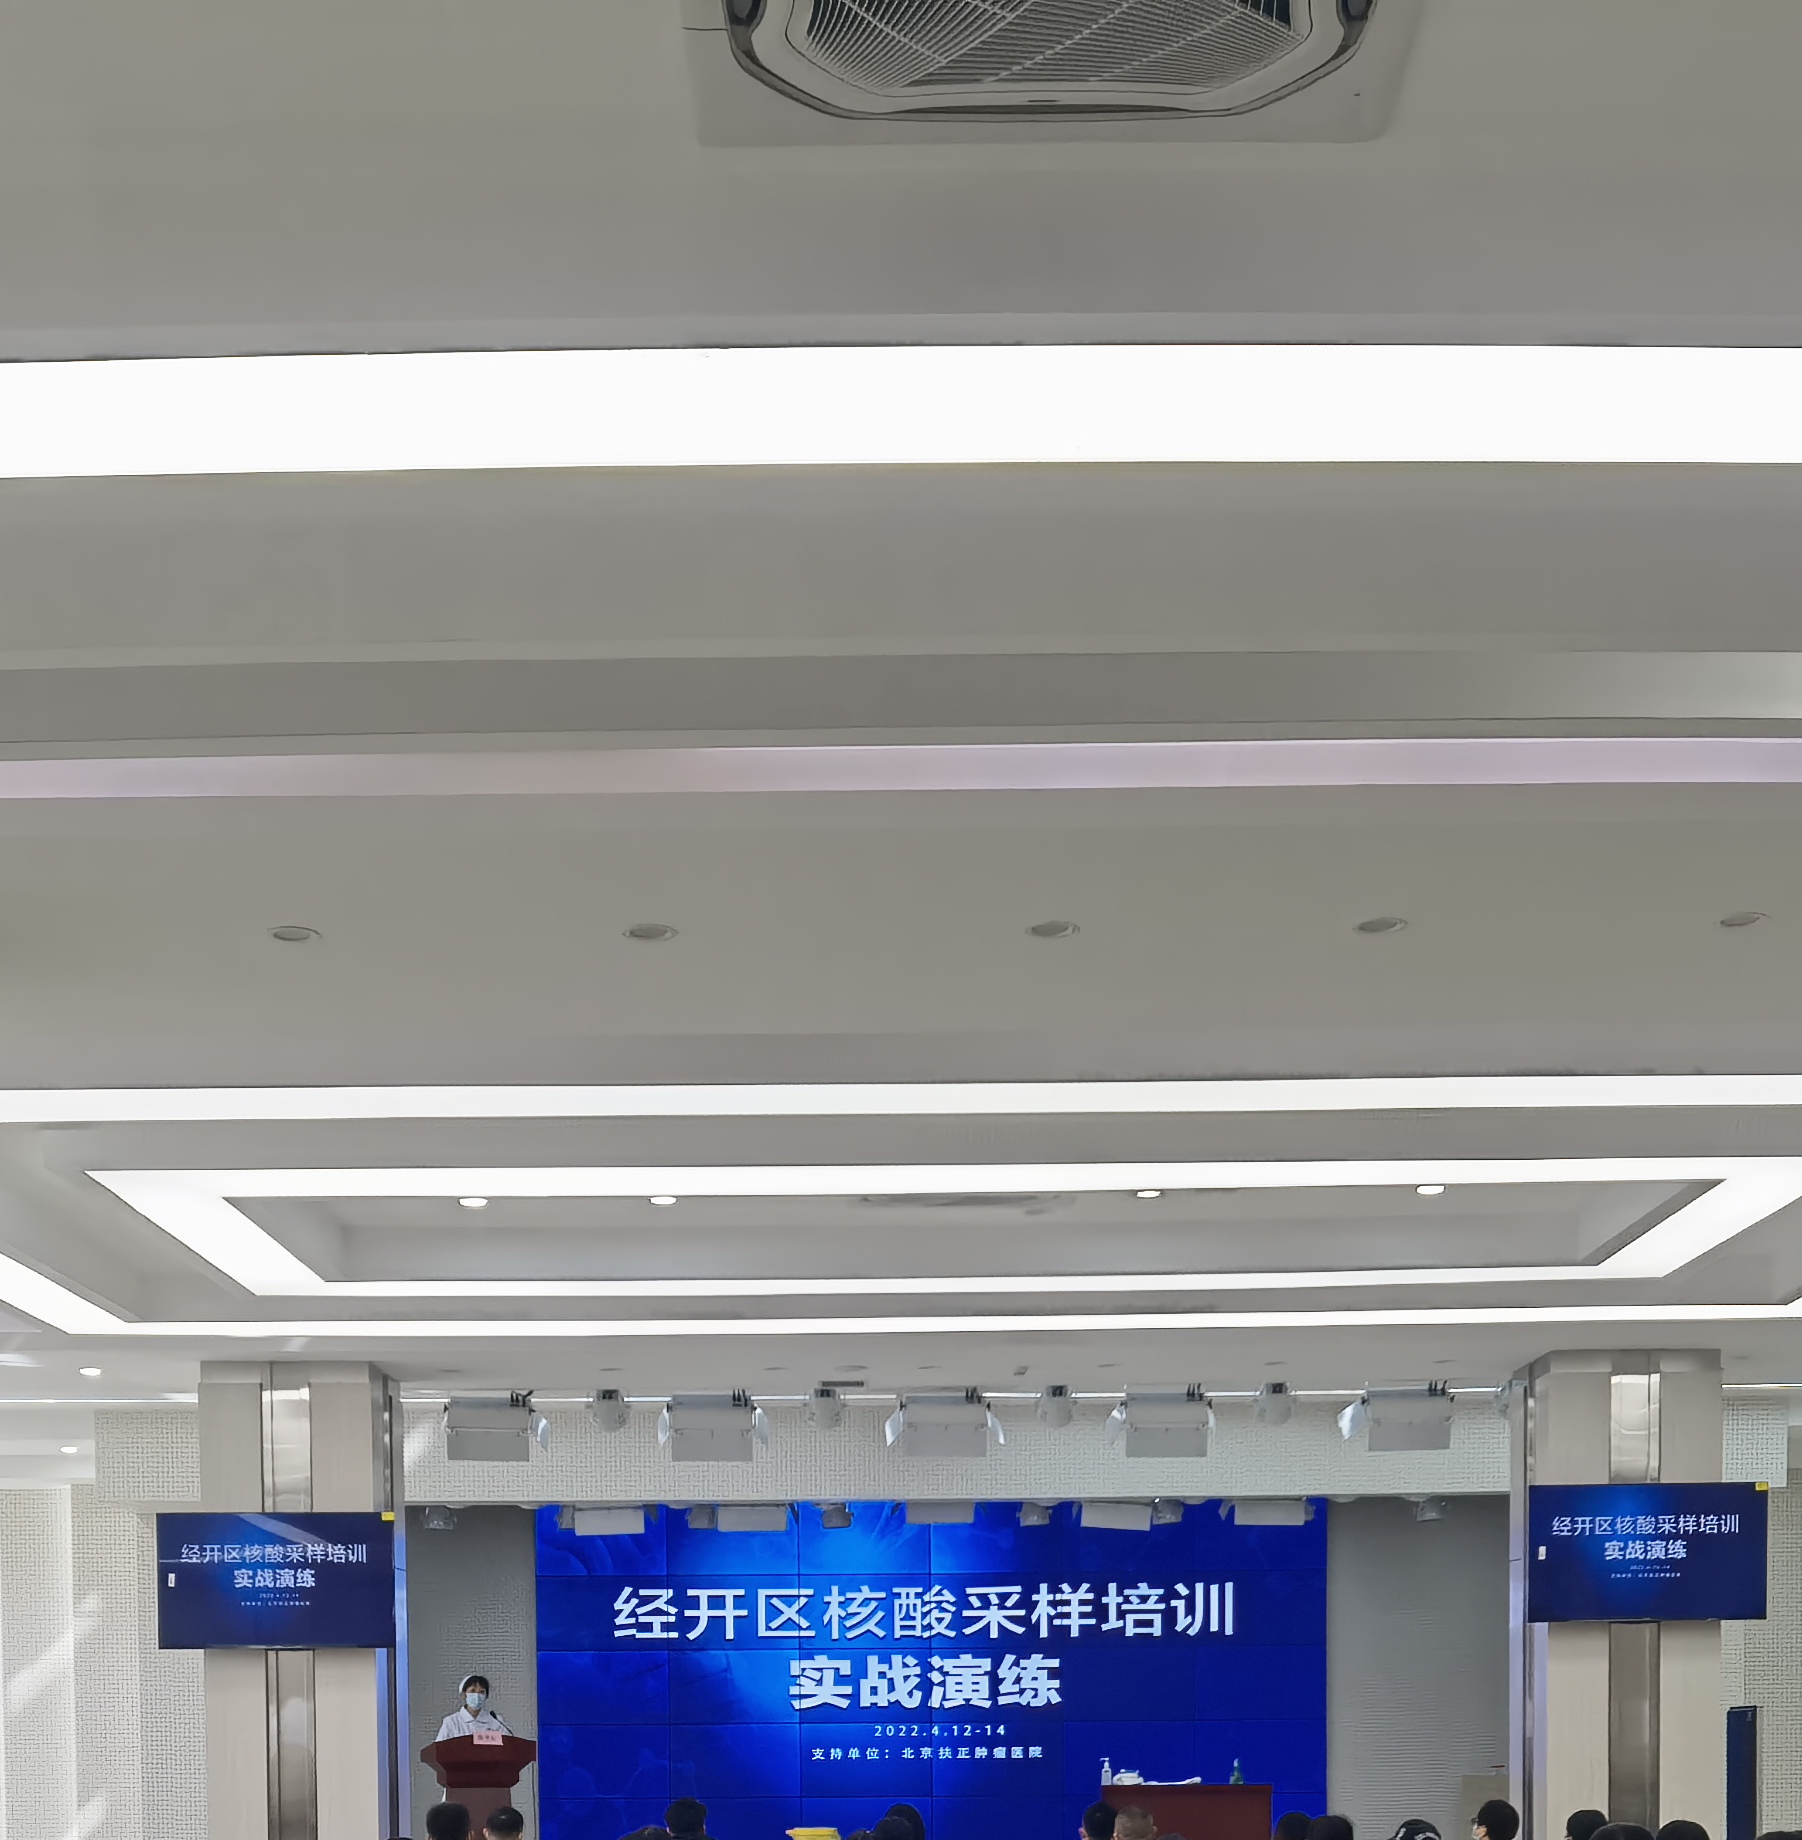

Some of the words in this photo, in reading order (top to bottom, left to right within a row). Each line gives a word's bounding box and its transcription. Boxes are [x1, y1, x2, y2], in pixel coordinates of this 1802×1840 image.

[1551, 1513, 1740, 1537] 经开区核酸采样培训
[181, 1543, 367, 1565] 经开区核酸采样培训
[1604, 1540, 1687, 1560] 实战演练
[234, 1568, 316, 1589] 实战演练
[612, 1581, 1235, 1642] 经开区核酸采样培训
[788, 1653, 1063, 1710] 实战演练
[873, 1724, 1006, 1737] 2022.4.12-14
